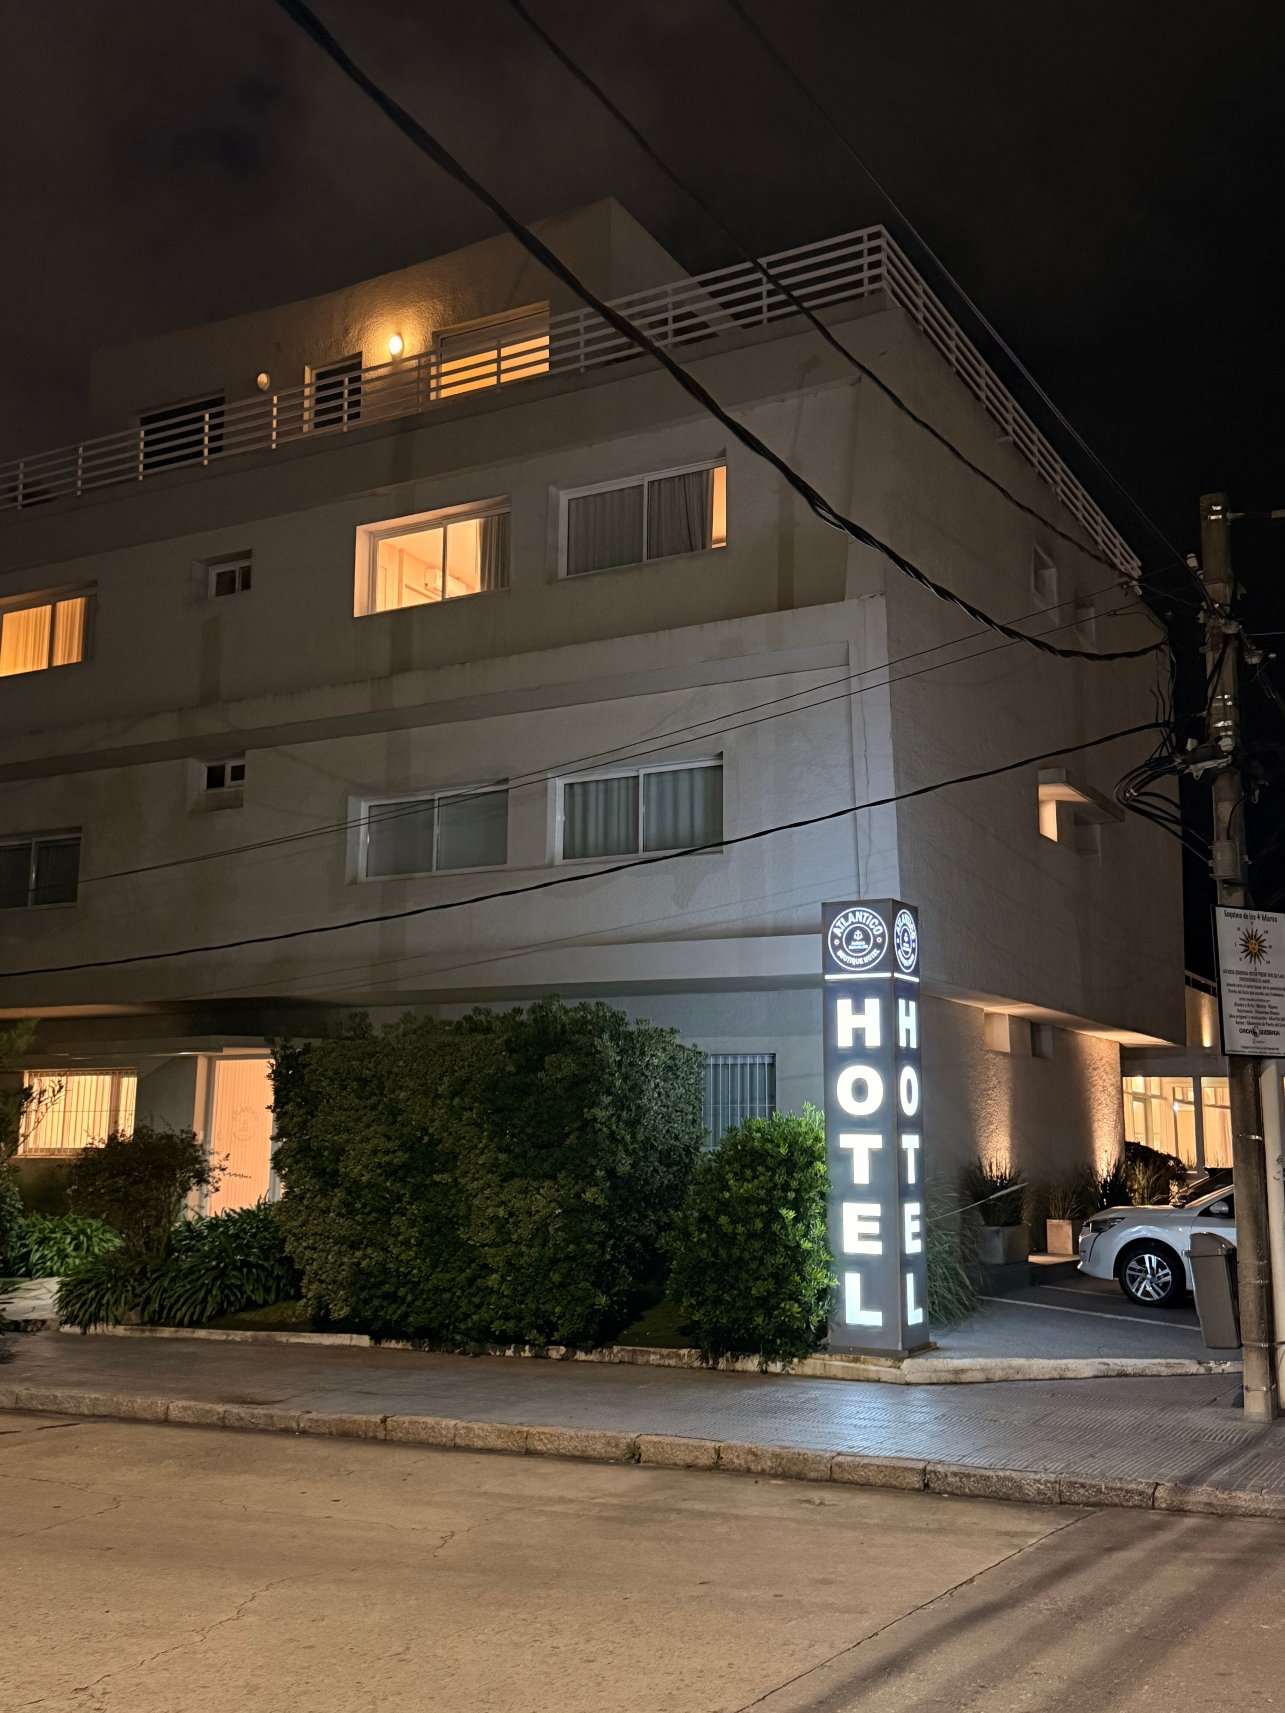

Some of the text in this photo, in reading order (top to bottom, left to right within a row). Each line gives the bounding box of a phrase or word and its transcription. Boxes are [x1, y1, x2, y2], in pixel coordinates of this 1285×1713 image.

[833, 911, 883, 937] ATLANTICO
[837, 998, 883, 1327] HOTEL
[899, 998, 924, 1326] HOTEL
